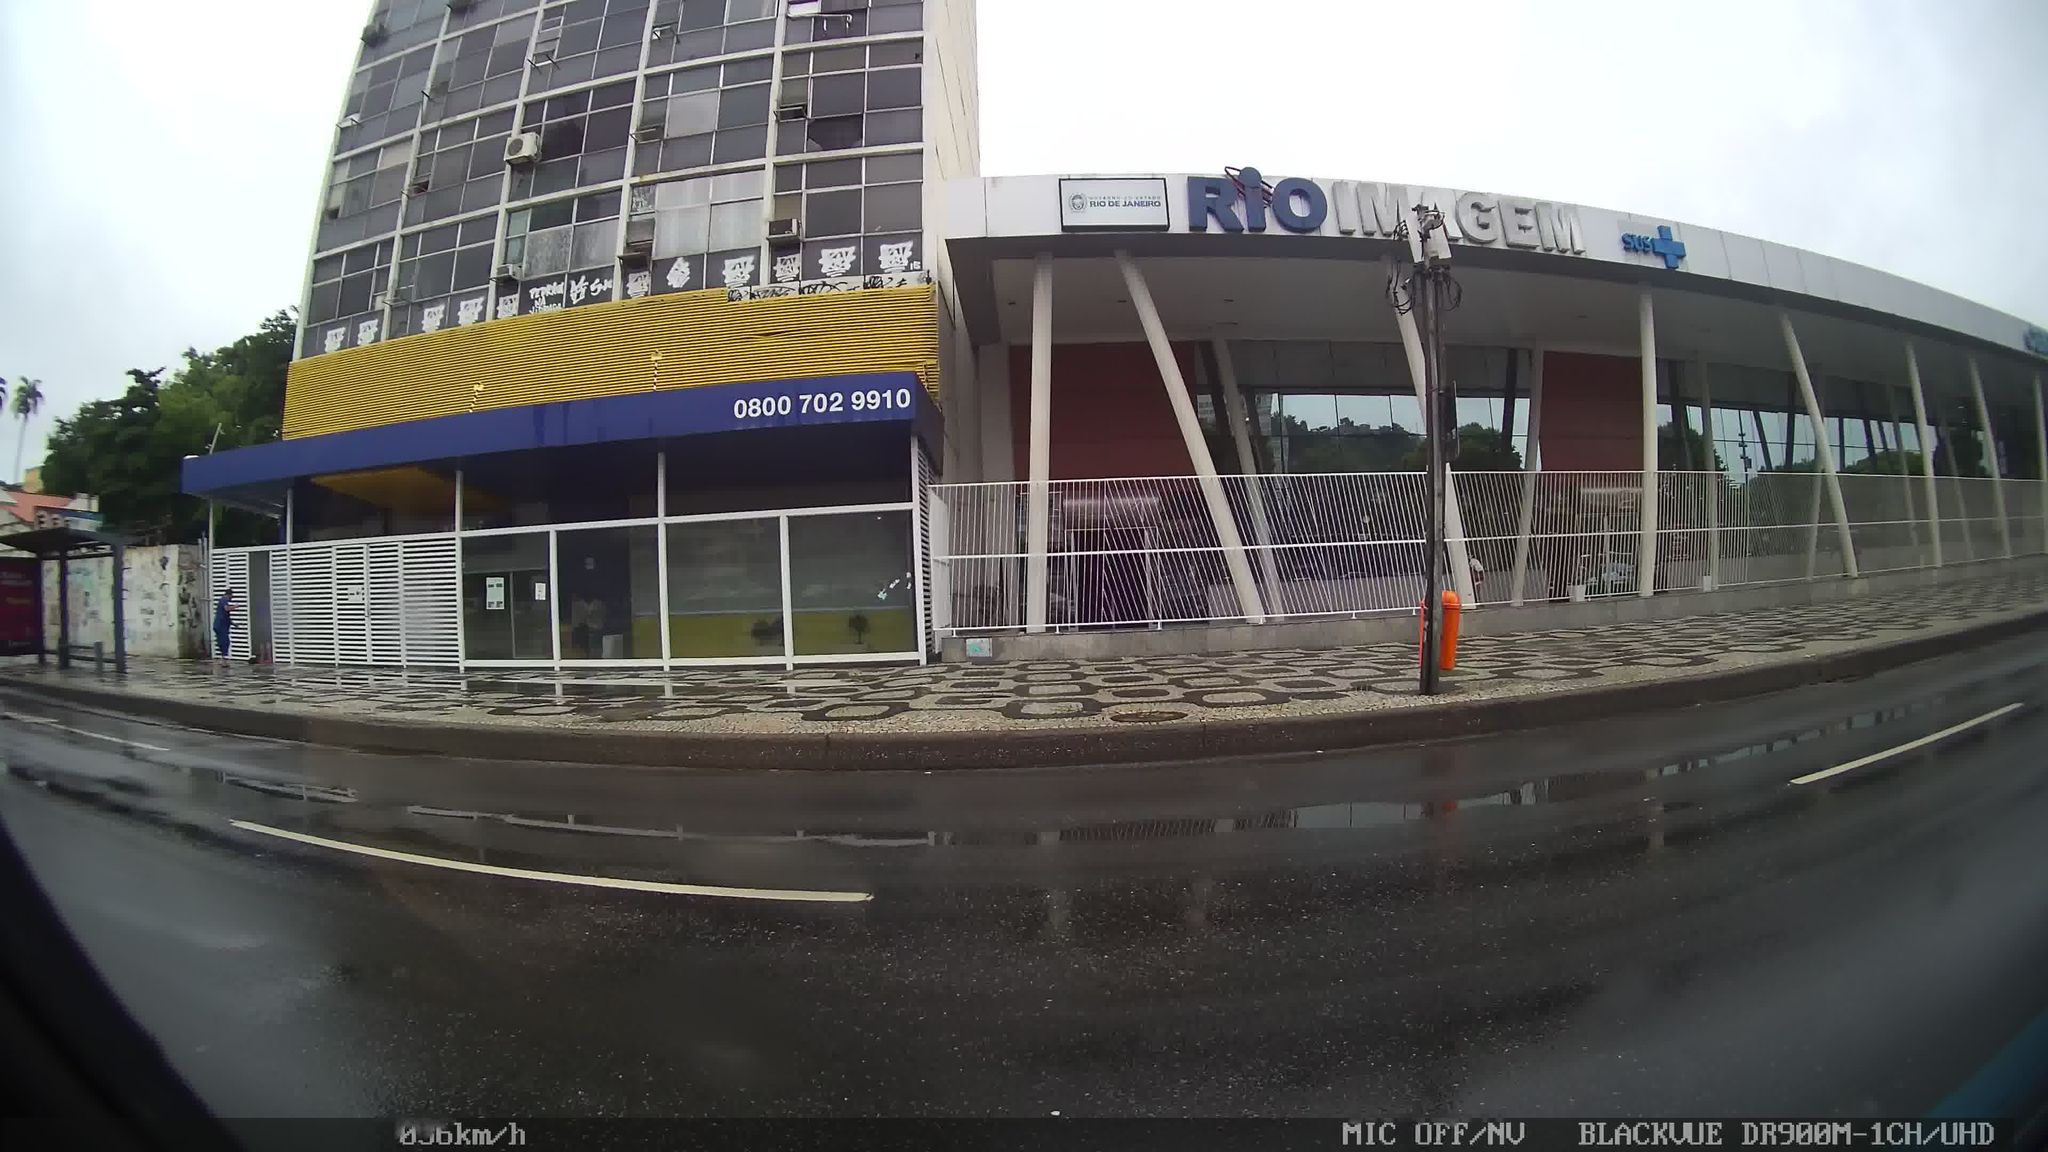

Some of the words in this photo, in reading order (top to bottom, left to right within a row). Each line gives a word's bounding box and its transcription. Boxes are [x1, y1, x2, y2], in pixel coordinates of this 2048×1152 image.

[1089, 200, 1106, 208] RIO
[1108, 200, 1120, 208] DE
[1122, 200, 1161, 208] JANEIRO
[1621, 233, 1653, 253] SUS
[733, 395, 792, 419] 0800
[799, 392, 844, 414] 702
[851, 388, 911, 411] 9910
